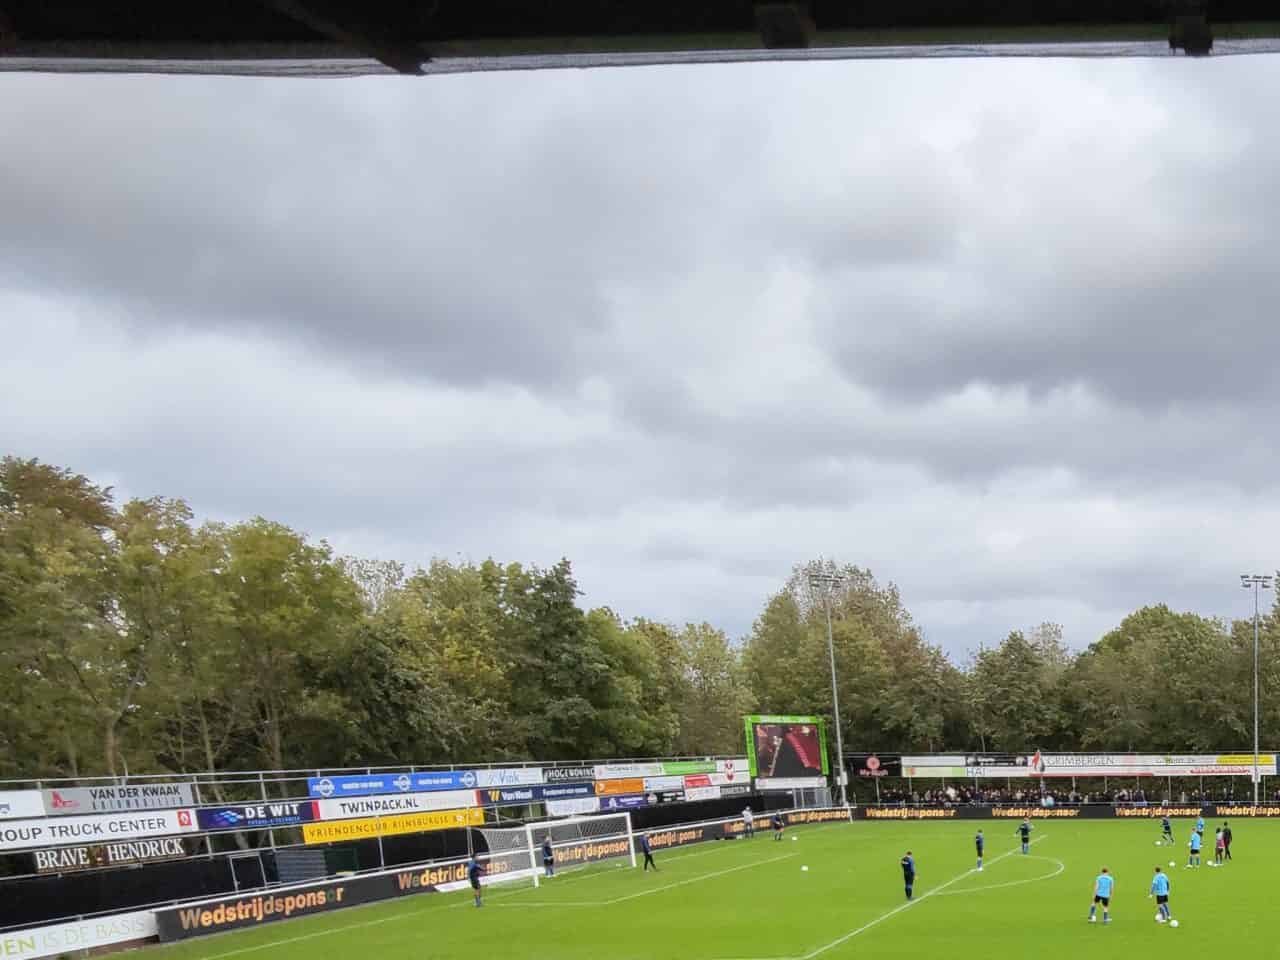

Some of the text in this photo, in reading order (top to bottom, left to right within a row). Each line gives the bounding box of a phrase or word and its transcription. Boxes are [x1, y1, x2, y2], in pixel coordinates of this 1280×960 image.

[89, 784, 181, 799] VAN DER KWAAK
[244, 803, 299, 819] DE WIT
[340, 798, 420, 815] TWINPACK.NL
[0, 817, 167, 842] OUP TRUCK CENTER
[35, 838, 185, 869] BRAVE HENDRICK
[178, 886, 345, 930] Wedstrijdsponsor
